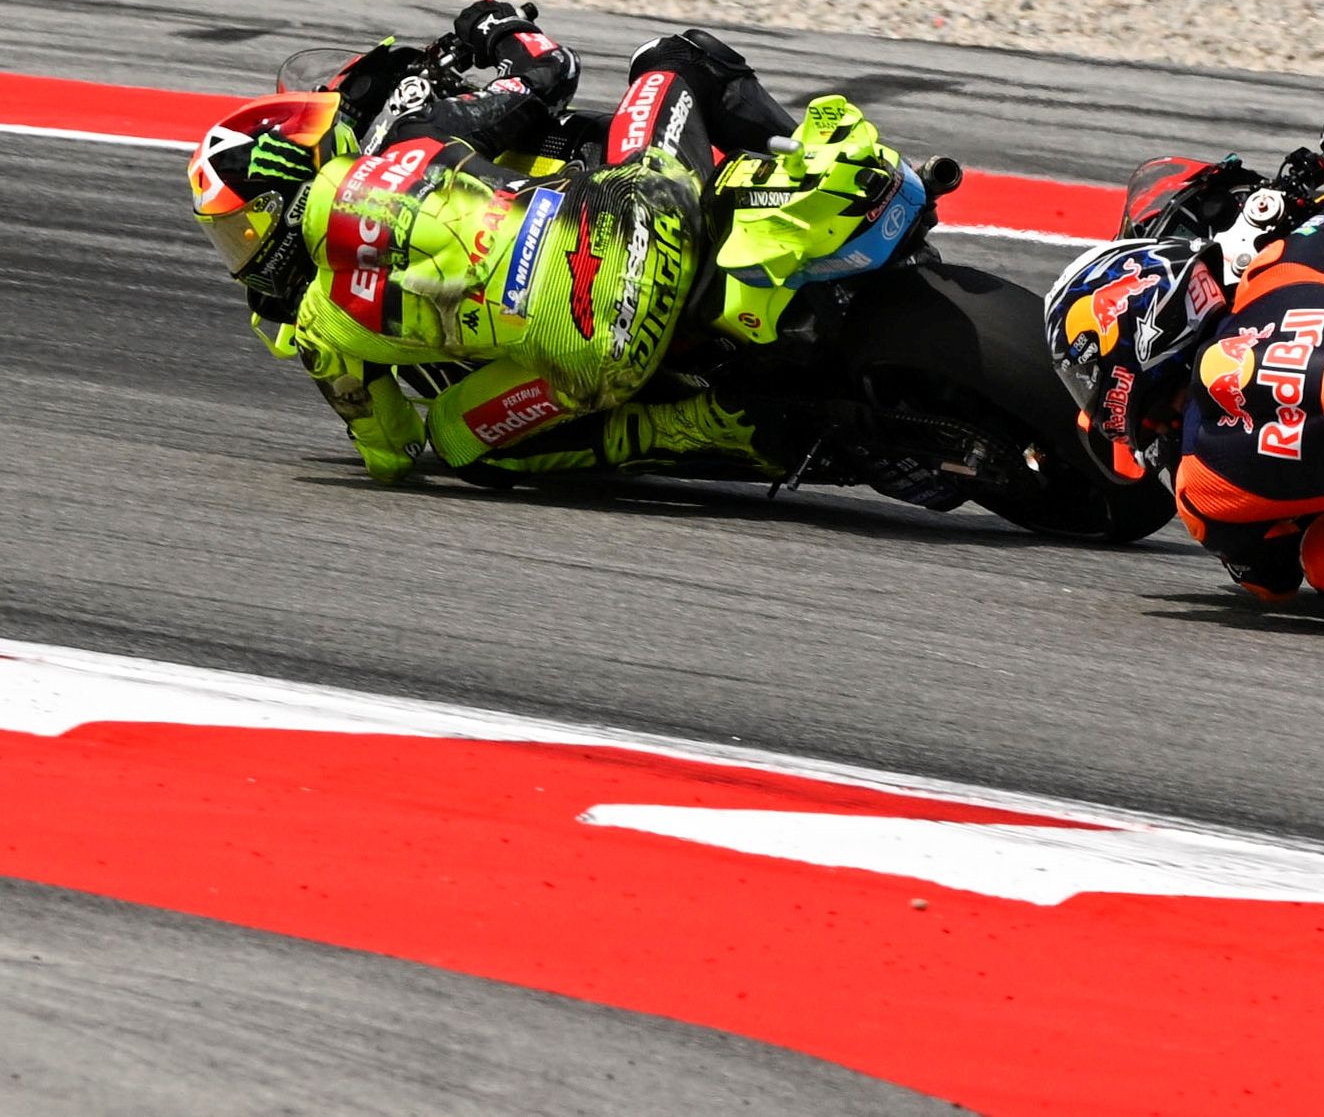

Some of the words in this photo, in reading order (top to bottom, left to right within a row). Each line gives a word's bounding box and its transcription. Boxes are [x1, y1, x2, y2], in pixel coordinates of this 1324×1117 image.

[621, 73, 665, 152] Enduro
[659, 90, 693, 158] inestars
[514, 197, 552, 294] MICHELIN
[1258, 369, 1306, 461] Red
